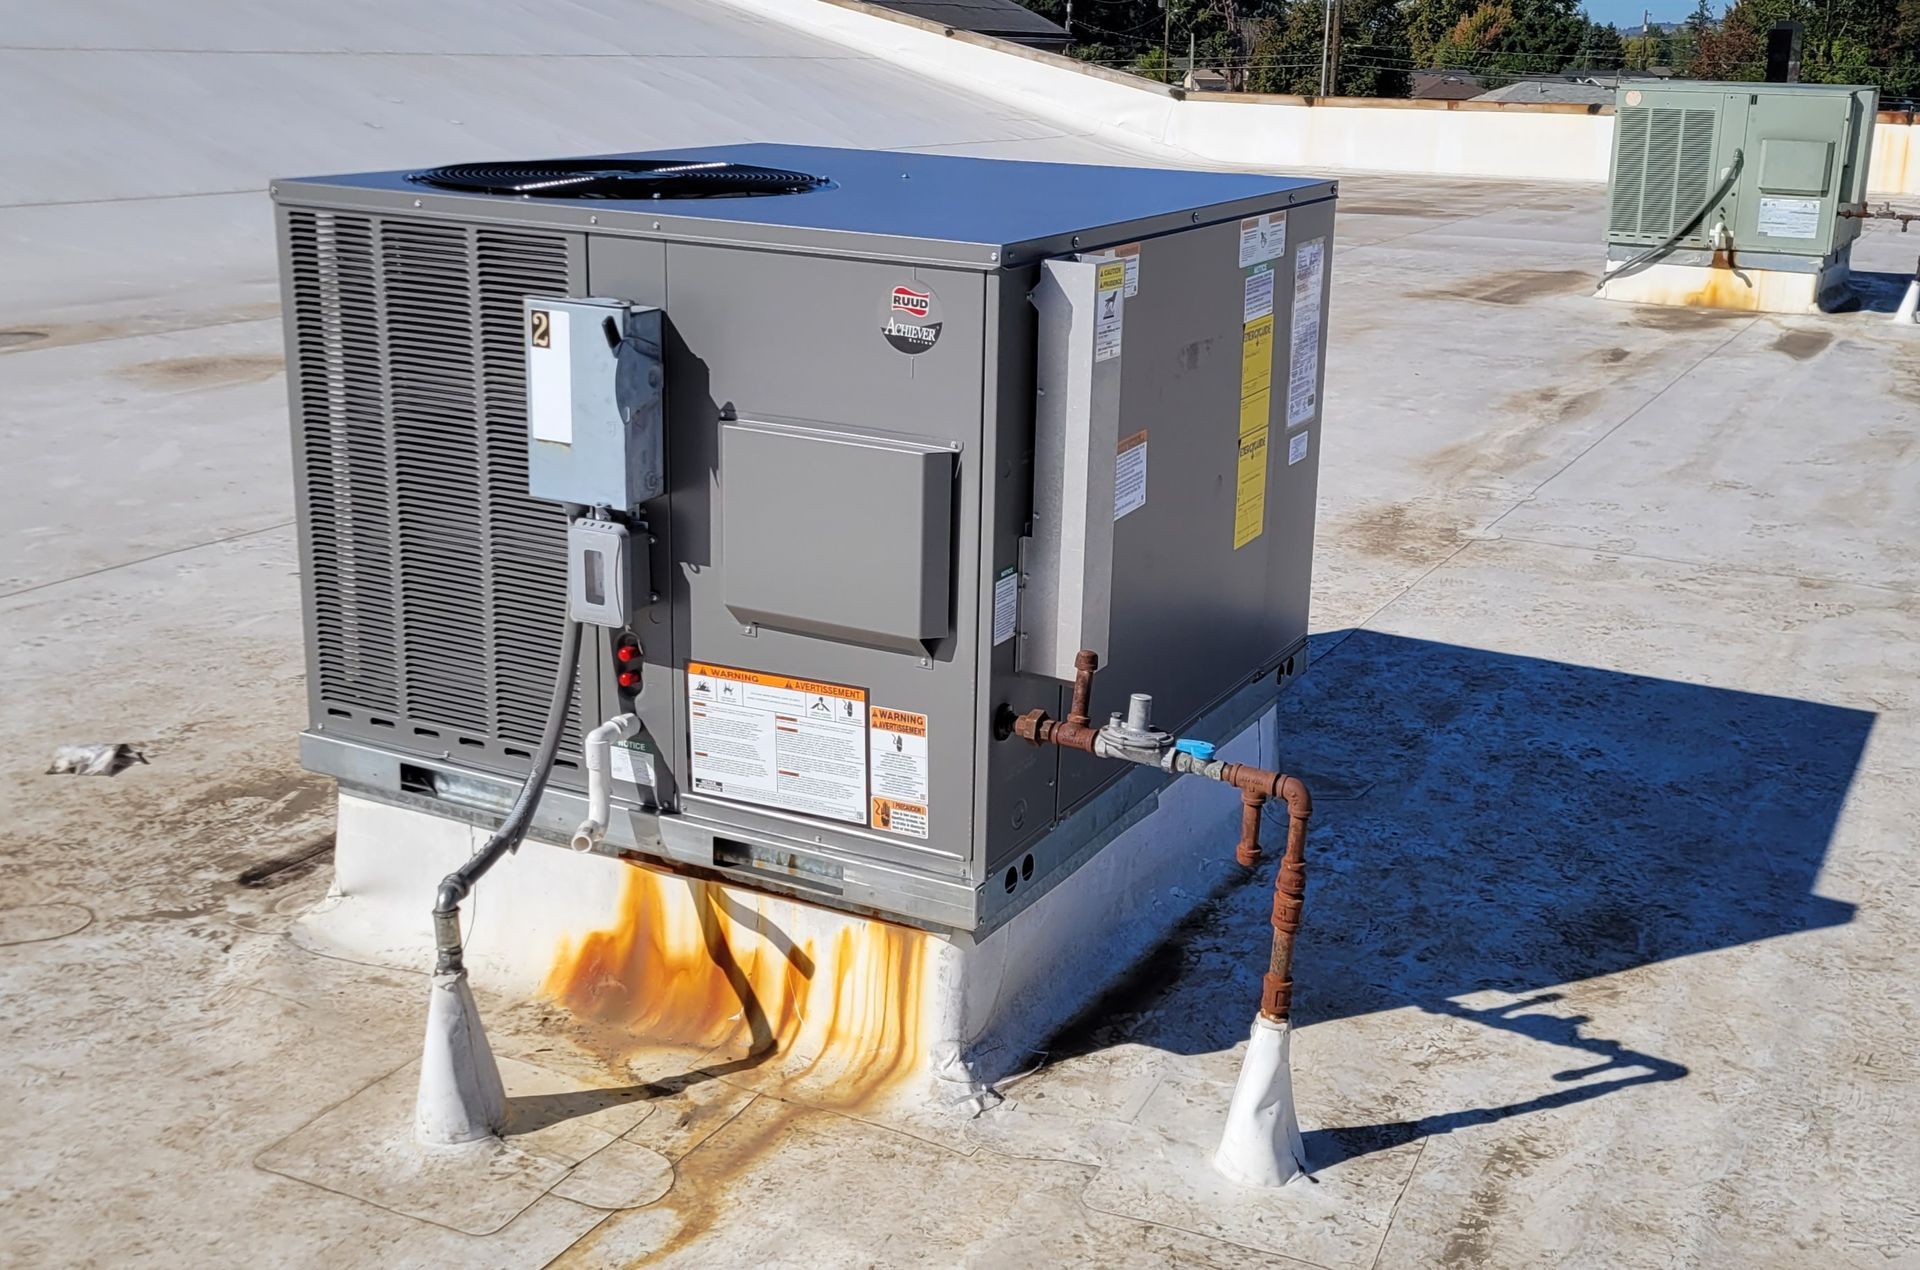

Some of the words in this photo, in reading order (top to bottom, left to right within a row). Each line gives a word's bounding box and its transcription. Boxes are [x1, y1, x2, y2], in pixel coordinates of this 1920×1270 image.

[893, 295, 929, 309] RUUD
[533, 312, 549, 347] 2
[884, 316, 936, 342] ACHIEVER
[710, 668, 759, 683] WARNING
[794, 681, 861, 700] AVERTISSEMENT
[879, 709, 924, 726] WARNING
[879, 721, 926, 737] AVERTISSEMENT
[617, 740, 646, 751] NOTICE
